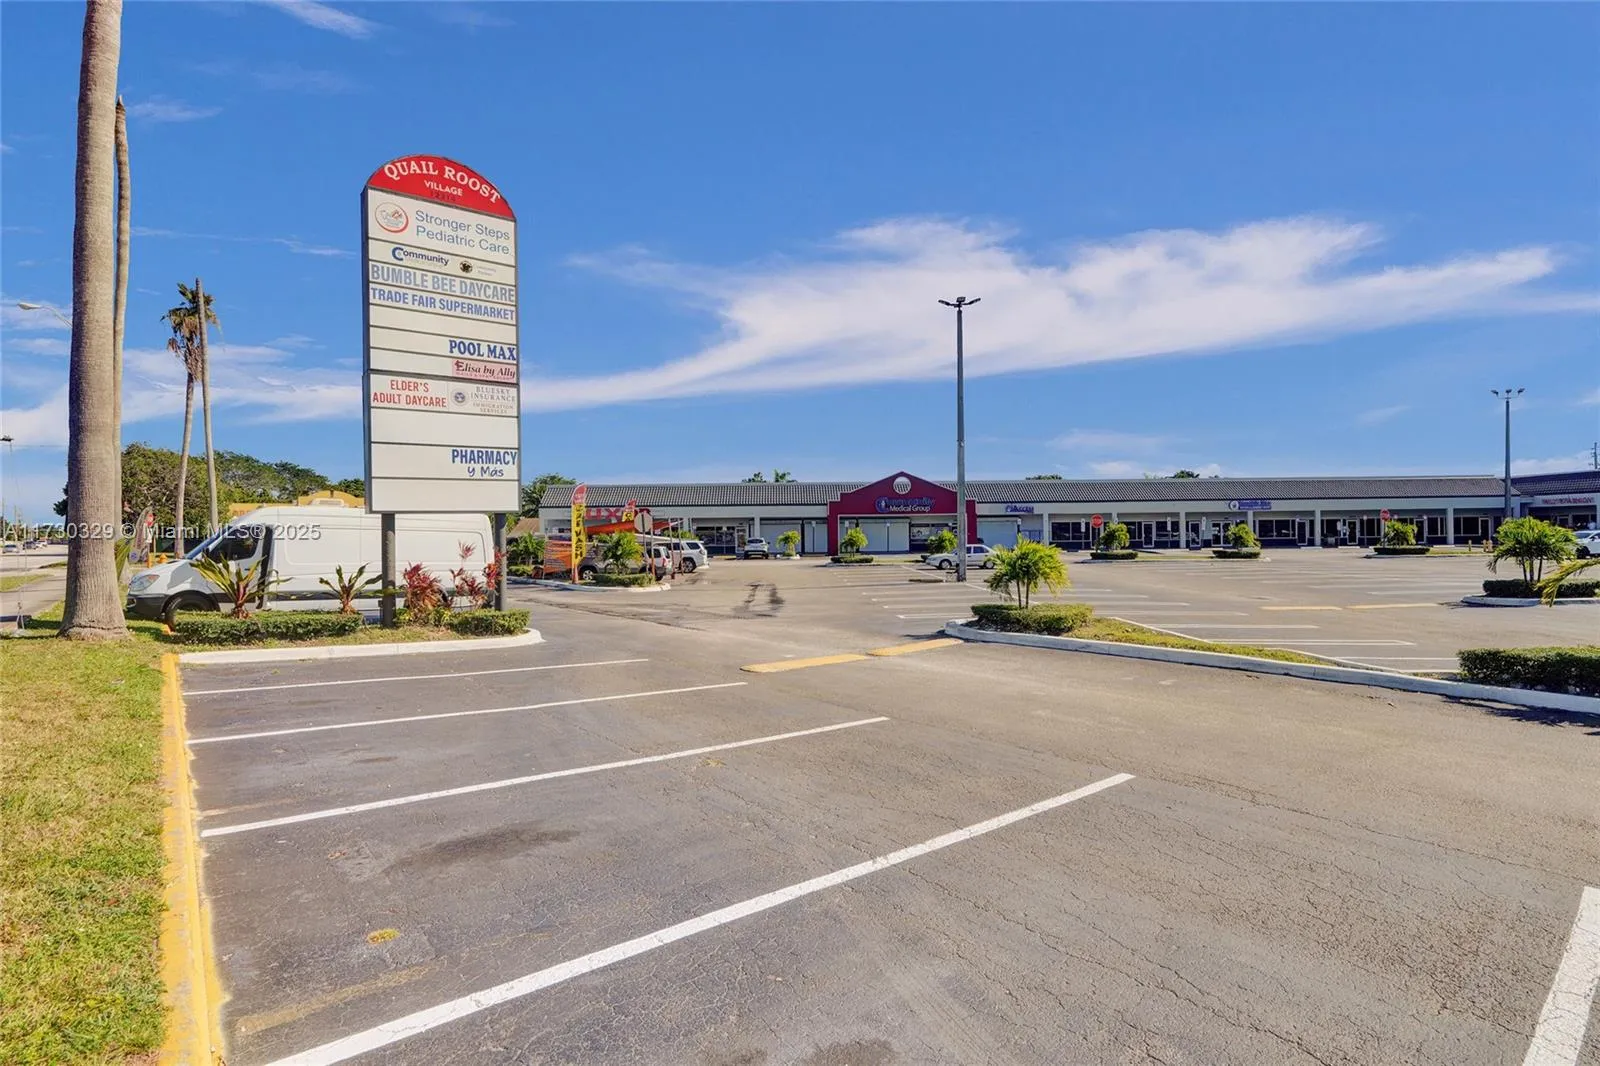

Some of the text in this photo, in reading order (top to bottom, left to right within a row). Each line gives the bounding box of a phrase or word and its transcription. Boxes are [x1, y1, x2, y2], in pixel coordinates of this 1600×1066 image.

[384, 160, 501, 204] QUAIL ROOST
[424, 179, 463, 196] VILLAGE
[416, 210, 471, 232] Stronger
[475, 223, 510, 240] Steps
[416, 225, 509, 255] Pediatric Care
[392, 246, 449, 266] Community
[371, 264, 428, 288] BUMBLE
[432, 275, 456, 293] BEE
[459, 281, 514, 302] DAYCARE
[371, 287, 515, 321] TRADE FAIR SUPERMARKET
[449, 339, 517, 361] POOL MAX
[454, 360, 481, 373] Elisa
[483, 365, 495, 377] by
[498, 367, 516, 379] Ally
[390, 379, 429, 393] ELDER'S
[372, 392, 447, 408] ADULT DAYCARE
[451, 448, 518, 466] PHARMACY
[480, 466, 504, 477] Más
